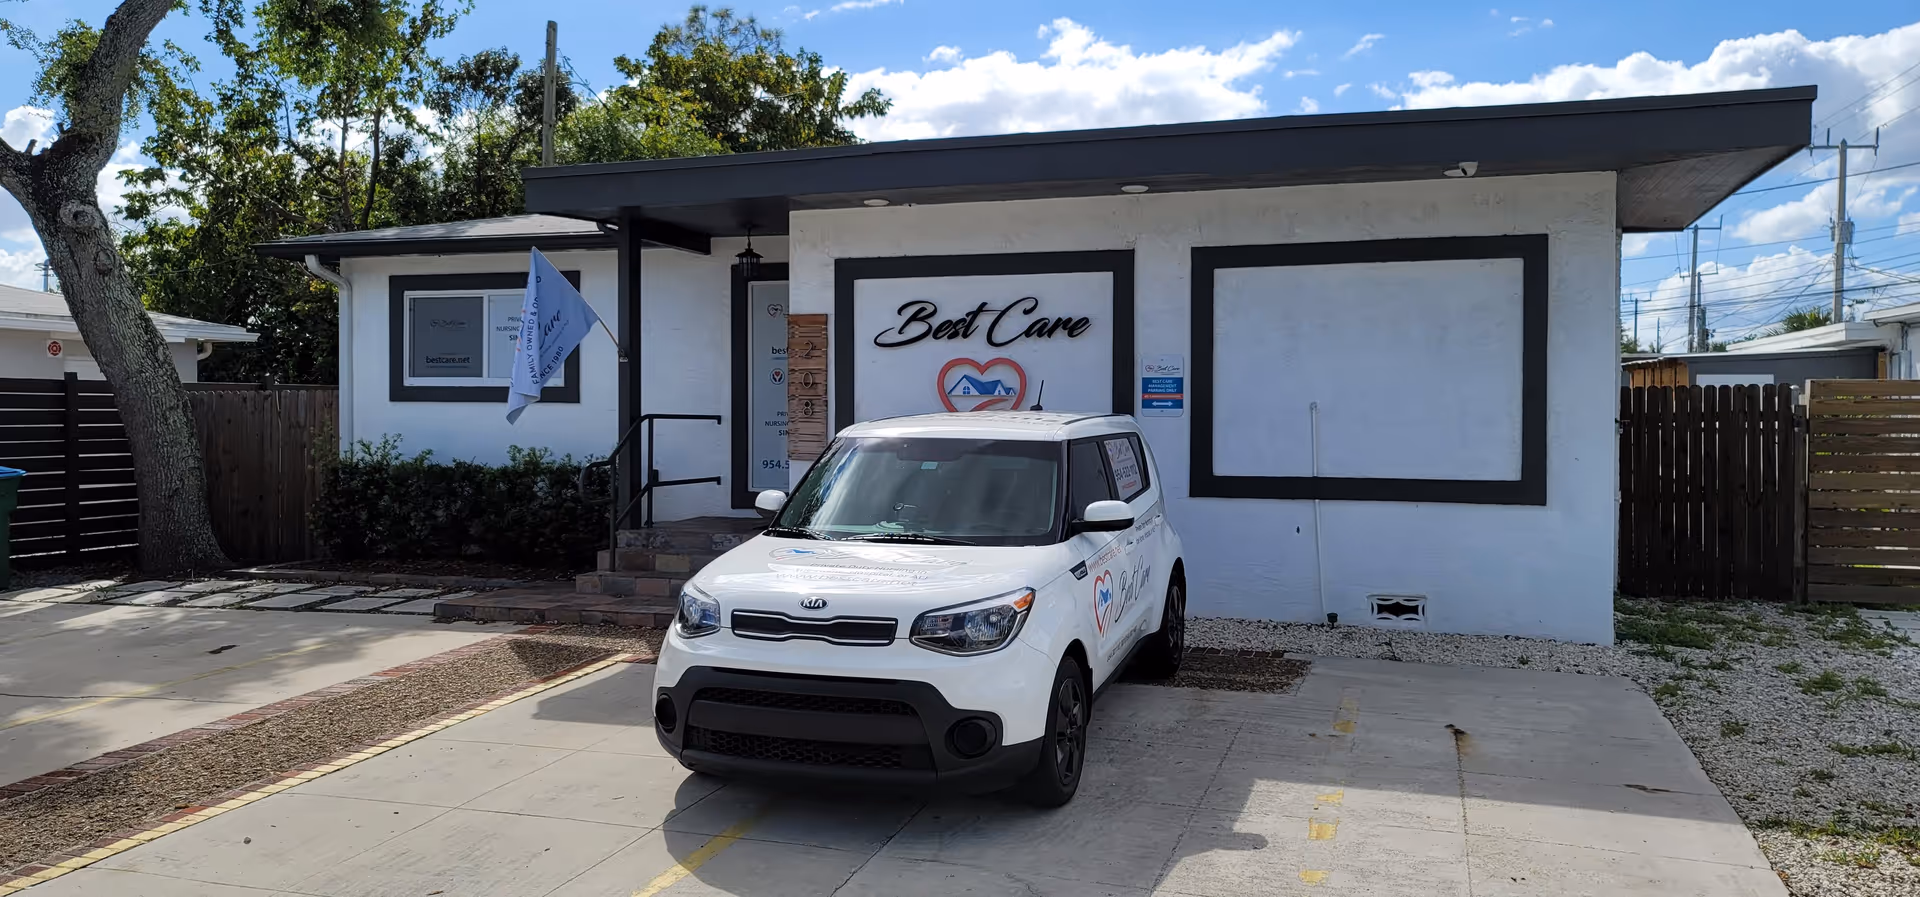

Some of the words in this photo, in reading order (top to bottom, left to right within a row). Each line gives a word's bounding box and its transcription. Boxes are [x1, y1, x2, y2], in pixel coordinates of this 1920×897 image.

[526, 318, 535, 350] OWNED
[874, 300, 990, 348] Best
[986, 297, 1092, 348] Care
[425, 356, 471, 364] bestcare.net
[527, 354, 540, 385] FAMILY
[540, 363, 553, 381] NCE
[551, 346, 564, 365] 1980
[762, 460, 789, 469] 954.5
[802, 597, 823, 607] KIA
[1115, 564, 1138, 623] Best
